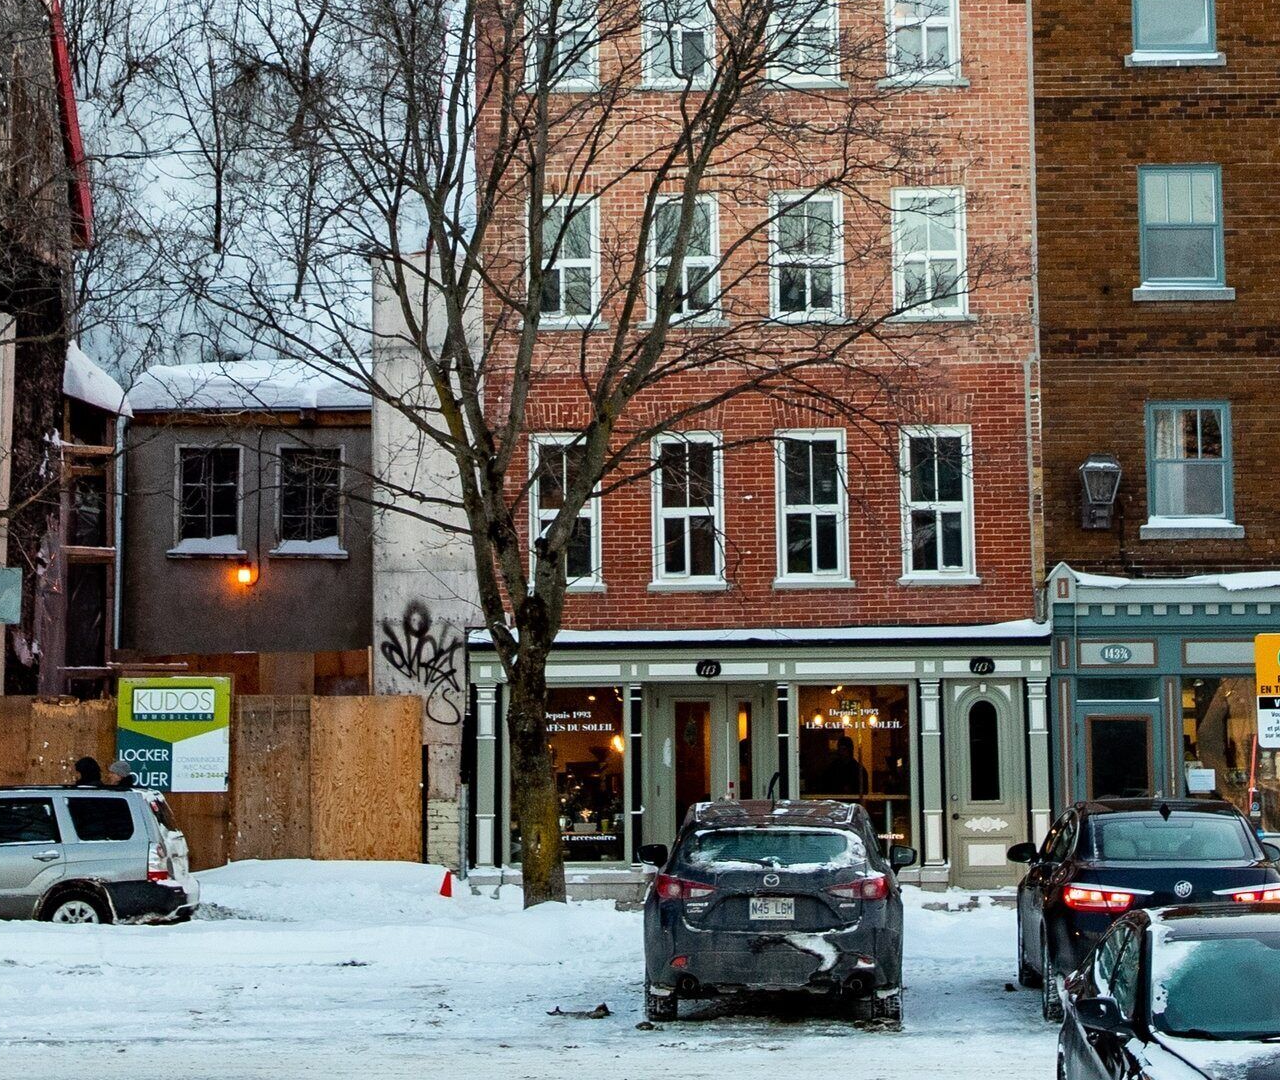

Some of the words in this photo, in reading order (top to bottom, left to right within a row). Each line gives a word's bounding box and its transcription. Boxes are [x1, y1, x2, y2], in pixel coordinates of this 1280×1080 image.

[1260, 685, 1272, 693] EN
[136, 691, 212, 711] KUDOS
[572, 711, 592, 719] 1993
[829, 708, 857, 717] Depuis
[860, 708, 879, 716] 1993
[567, 723, 580, 731] DU
[582, 723, 615, 731] SOLEIL
[806, 721, 823, 729] LES
[119, 749, 169, 761] LOCKER
[129, 771, 169, 787] OUER
[571, 832, 617, 841] accessoires
